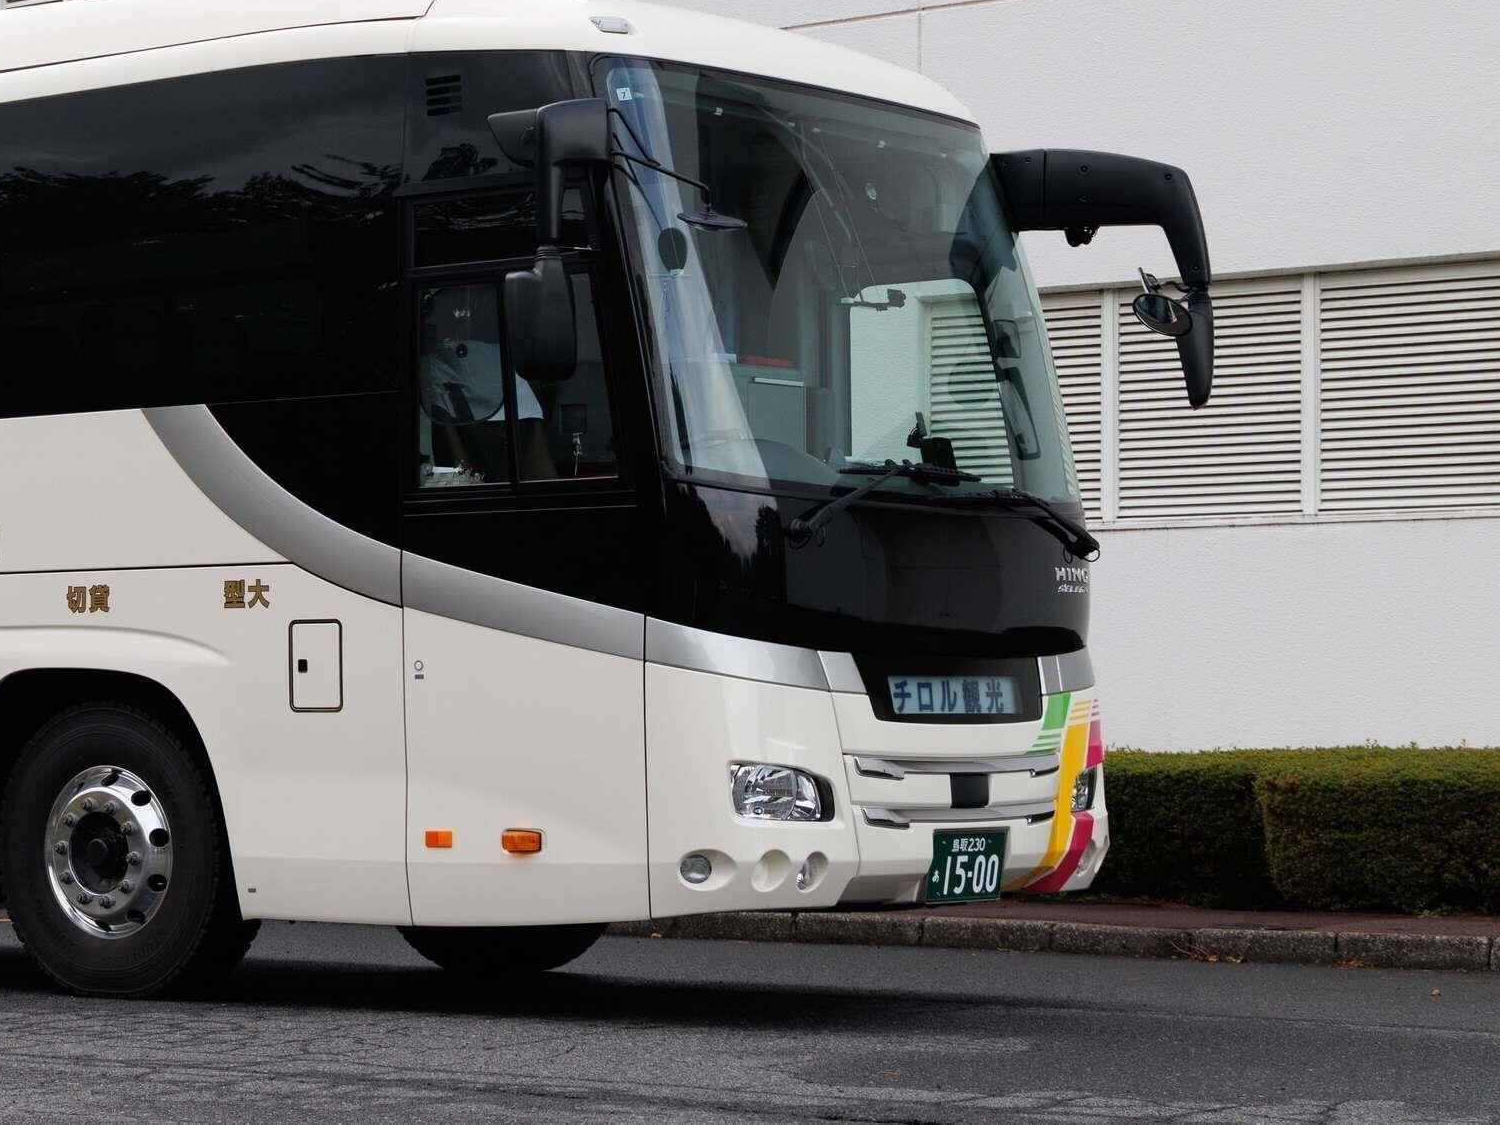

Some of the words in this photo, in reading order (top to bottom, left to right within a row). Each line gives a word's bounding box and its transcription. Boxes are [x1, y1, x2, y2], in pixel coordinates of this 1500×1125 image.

[892, 678, 1004, 713] チロル観光
[943, 854, 999, 895] 15-00
